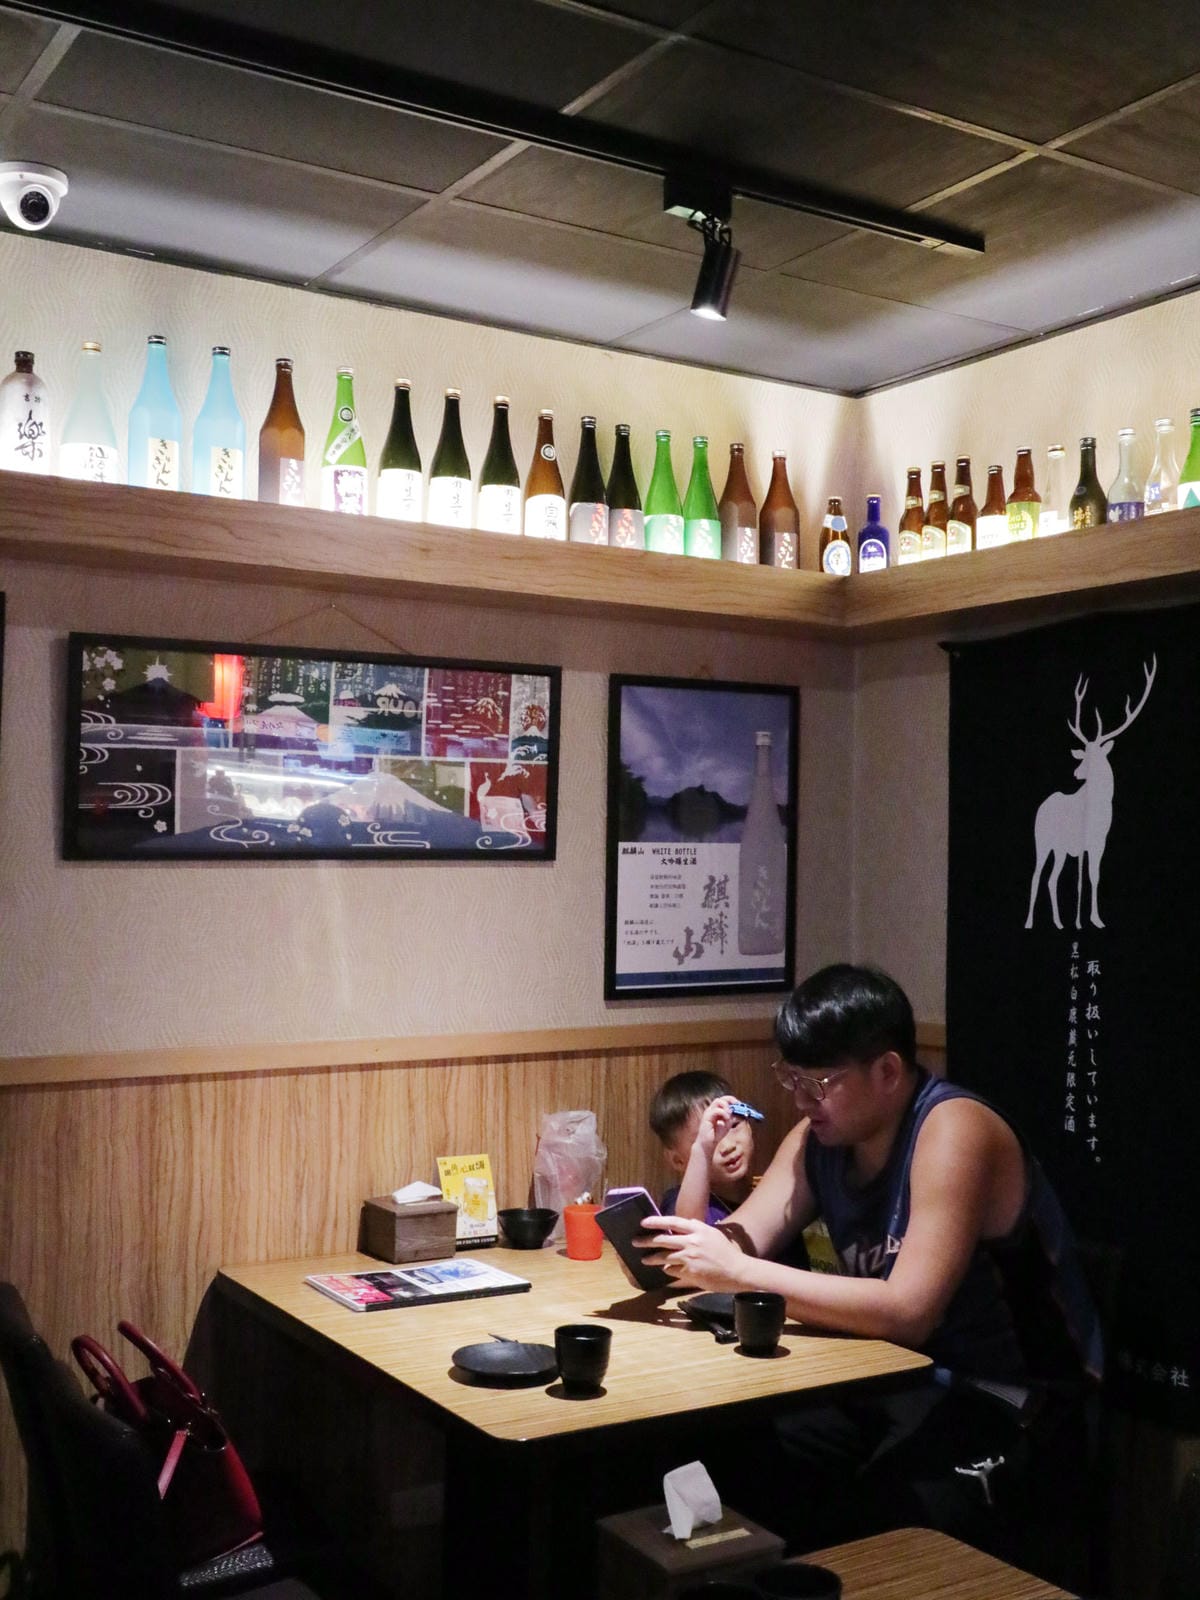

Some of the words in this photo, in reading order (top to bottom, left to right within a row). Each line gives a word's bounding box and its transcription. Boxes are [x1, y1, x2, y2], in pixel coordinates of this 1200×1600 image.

[652, 847, 671, 855] WHITE
[675, 847, 697, 855] BOTTLE
[1085, 960, 1102, 1163] 取り扱いしています。
